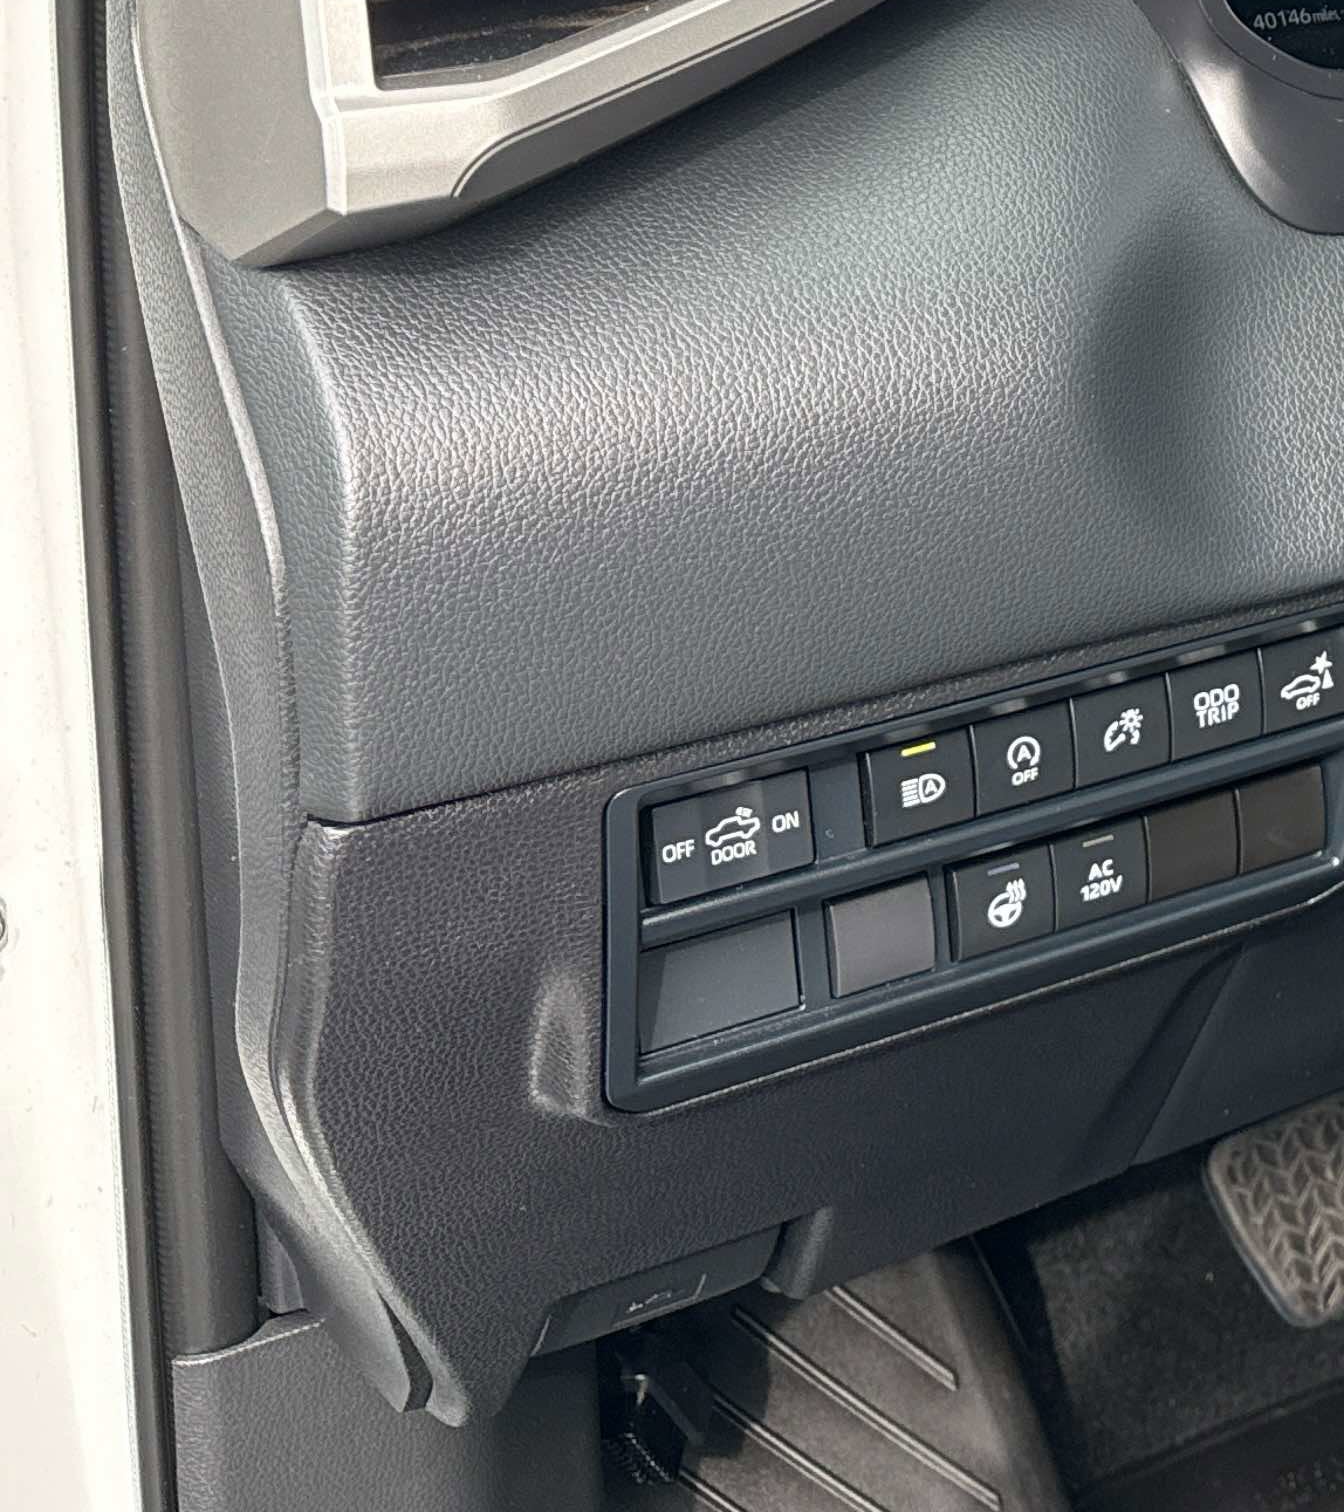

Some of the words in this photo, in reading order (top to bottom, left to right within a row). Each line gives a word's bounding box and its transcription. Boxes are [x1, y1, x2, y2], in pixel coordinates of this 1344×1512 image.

[1193, 682, 1241, 711] ODO
[1295, 691, 1321, 711] OFF
[1196, 700, 1241, 729] TRIP
[1011, 766, 1039, 786] OFF
[771, 810, 800, 834] ON
[661, 838, 696, 864] OFF
[709, 839, 758, 867] DOOR
[1088, 858, 1115, 882] AC
[1079, 873, 1124, 902] 120V
